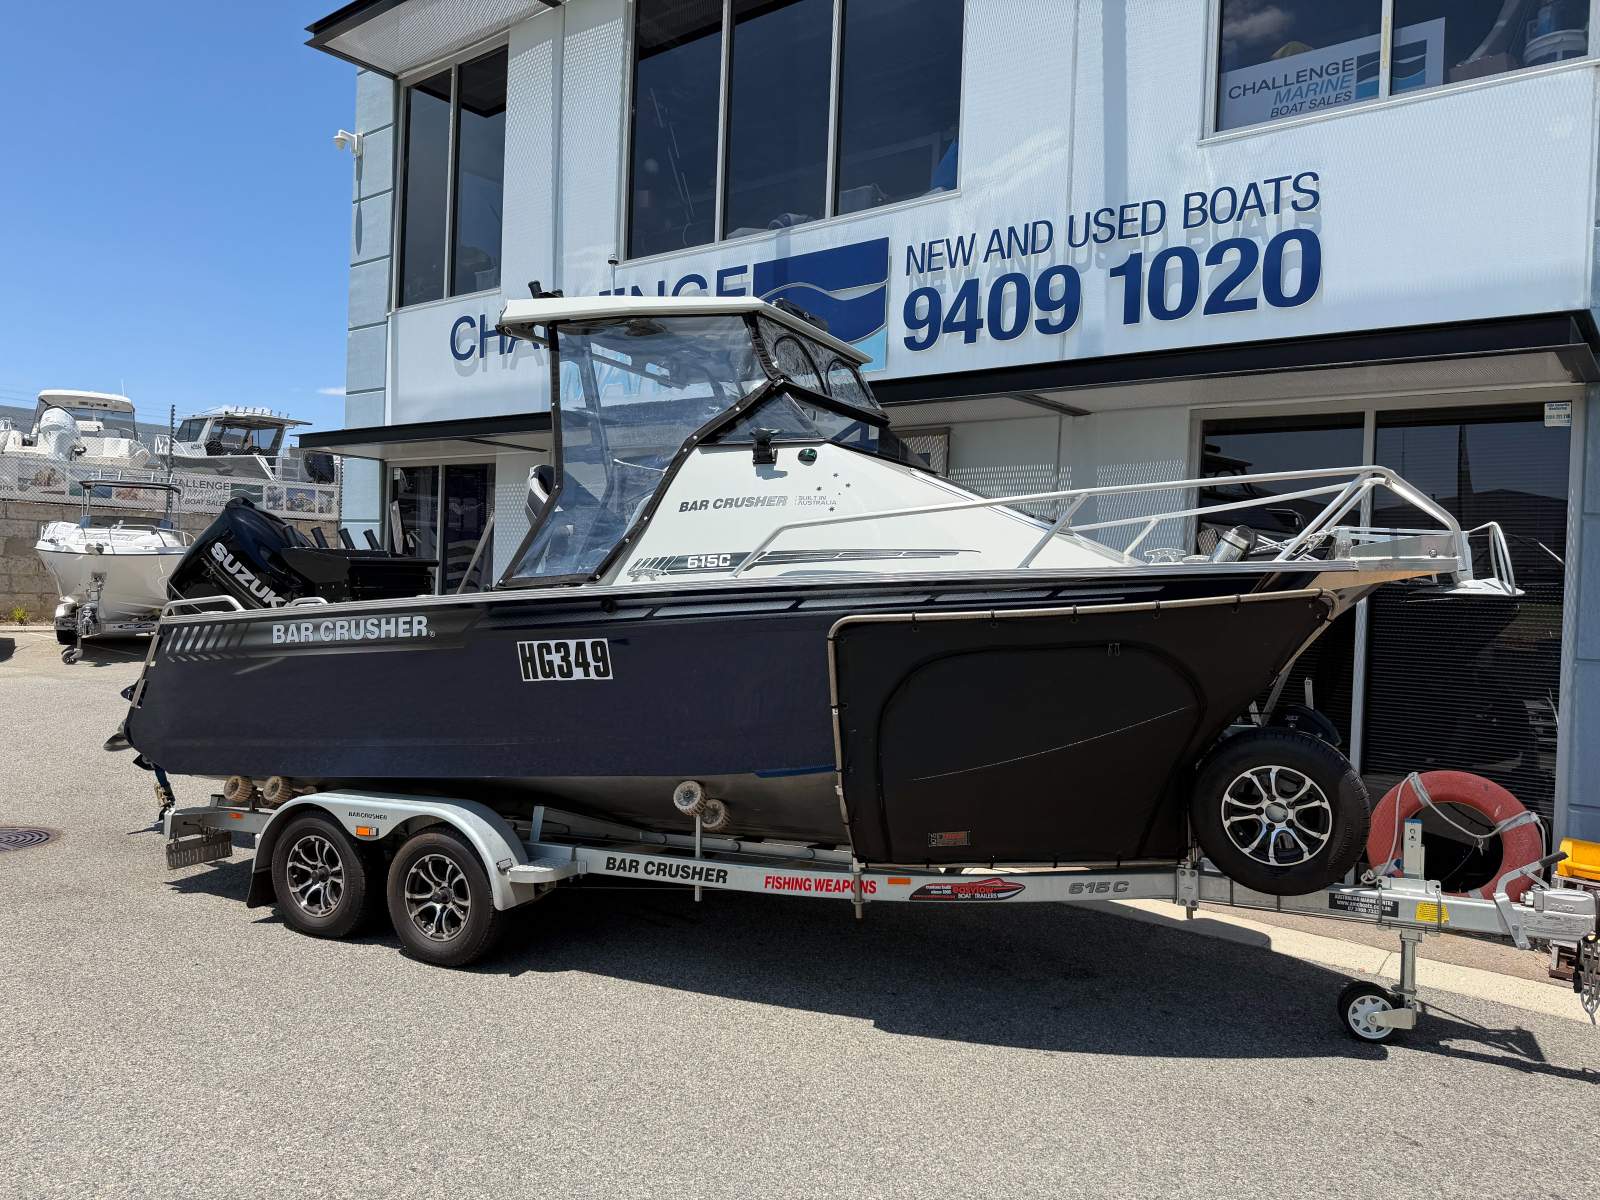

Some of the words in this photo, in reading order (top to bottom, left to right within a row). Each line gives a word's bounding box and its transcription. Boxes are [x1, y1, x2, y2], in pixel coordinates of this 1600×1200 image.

[1229, 57, 1354, 99] CHALLENGE
[1274, 73, 1353, 105] MARINE
[1270, 101, 1306, 118] BOAT
[1308, 90, 1352, 109] SALES
[905, 233, 976, 276] NEW
[983, 220, 1054, 263] AND
[1067, 199, 1166, 248] USED
[1183, 171, 1320, 229] BOATS
[902, 264, 1081, 351] 9409
[1109, 228, 1322, 325] 1020
[678, 499, 709, 513] BAR
[712, 495, 788, 510] CRUSHER
[211, 542, 290, 608] SUZUK
[687, 554, 731, 568] 615C
[272, 621, 313, 644] BAR
[519, 640, 611, 679] HG349
[605, 856, 639, 874] BAR
[643, 861, 728, 884] CRUSHER
[764, 875, 812, 891] FISHING
